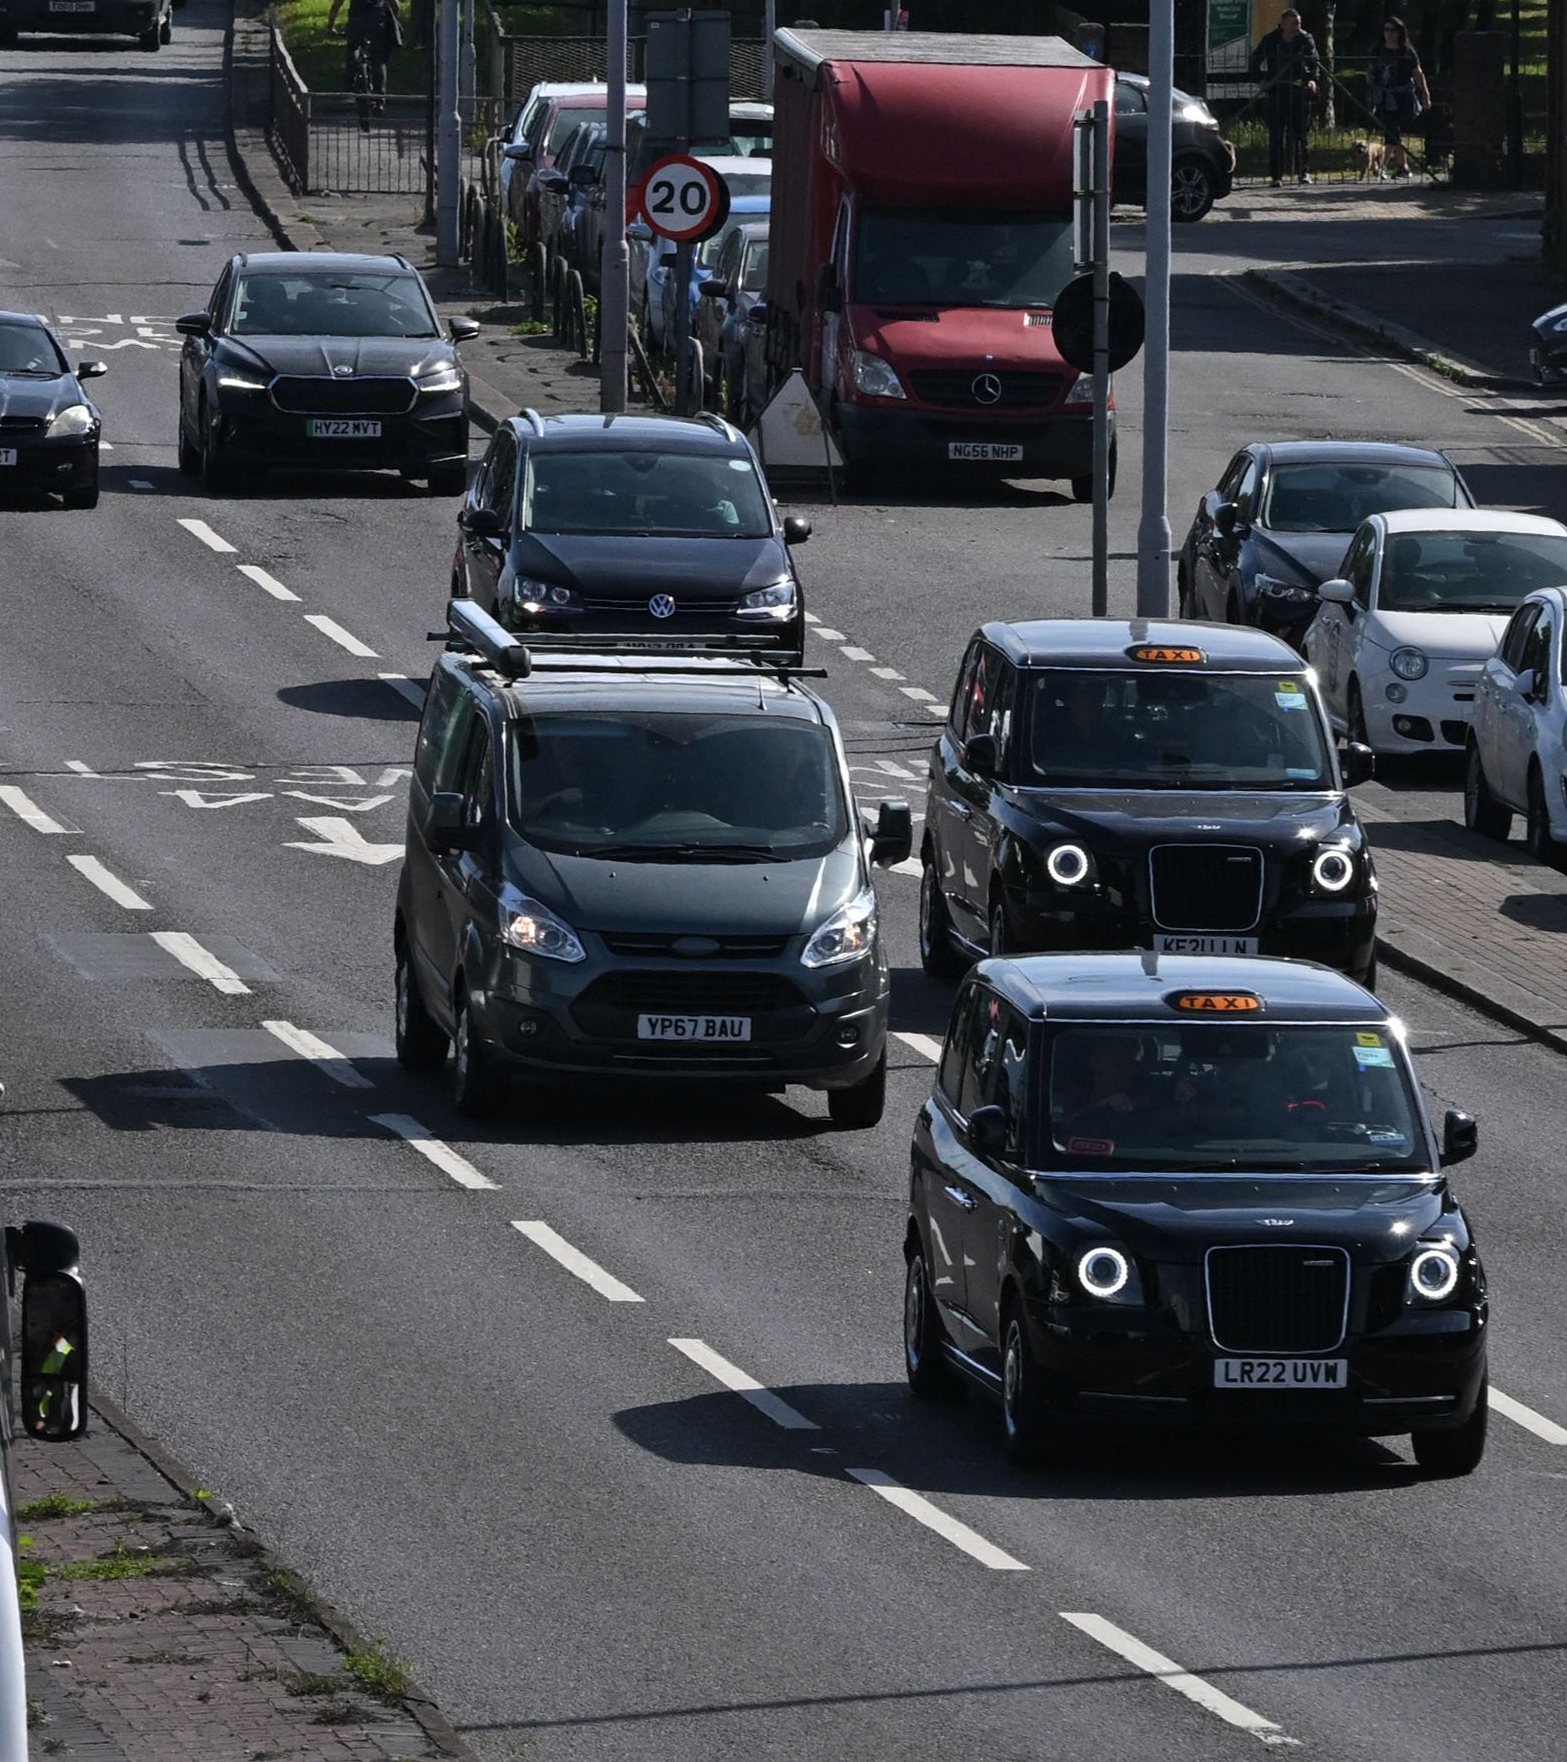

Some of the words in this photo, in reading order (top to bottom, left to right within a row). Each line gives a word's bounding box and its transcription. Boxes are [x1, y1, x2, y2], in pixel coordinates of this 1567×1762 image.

[651, 181, 708, 215] 20
[315, 422, 349, 434] HY22
[954, 445, 988, 457] NG56
[992, 446, 1018, 458] NHP
[1143, 650, 1194, 660] TAXI
[1186, 997, 1250, 1009] TAXI
[648, 1017, 698, 1037] YP67
[704, 1019, 743, 1038] BAU
[1224, 1361, 1286, 1383] LR22
[1293, 1362, 1338, 1383] UVW
